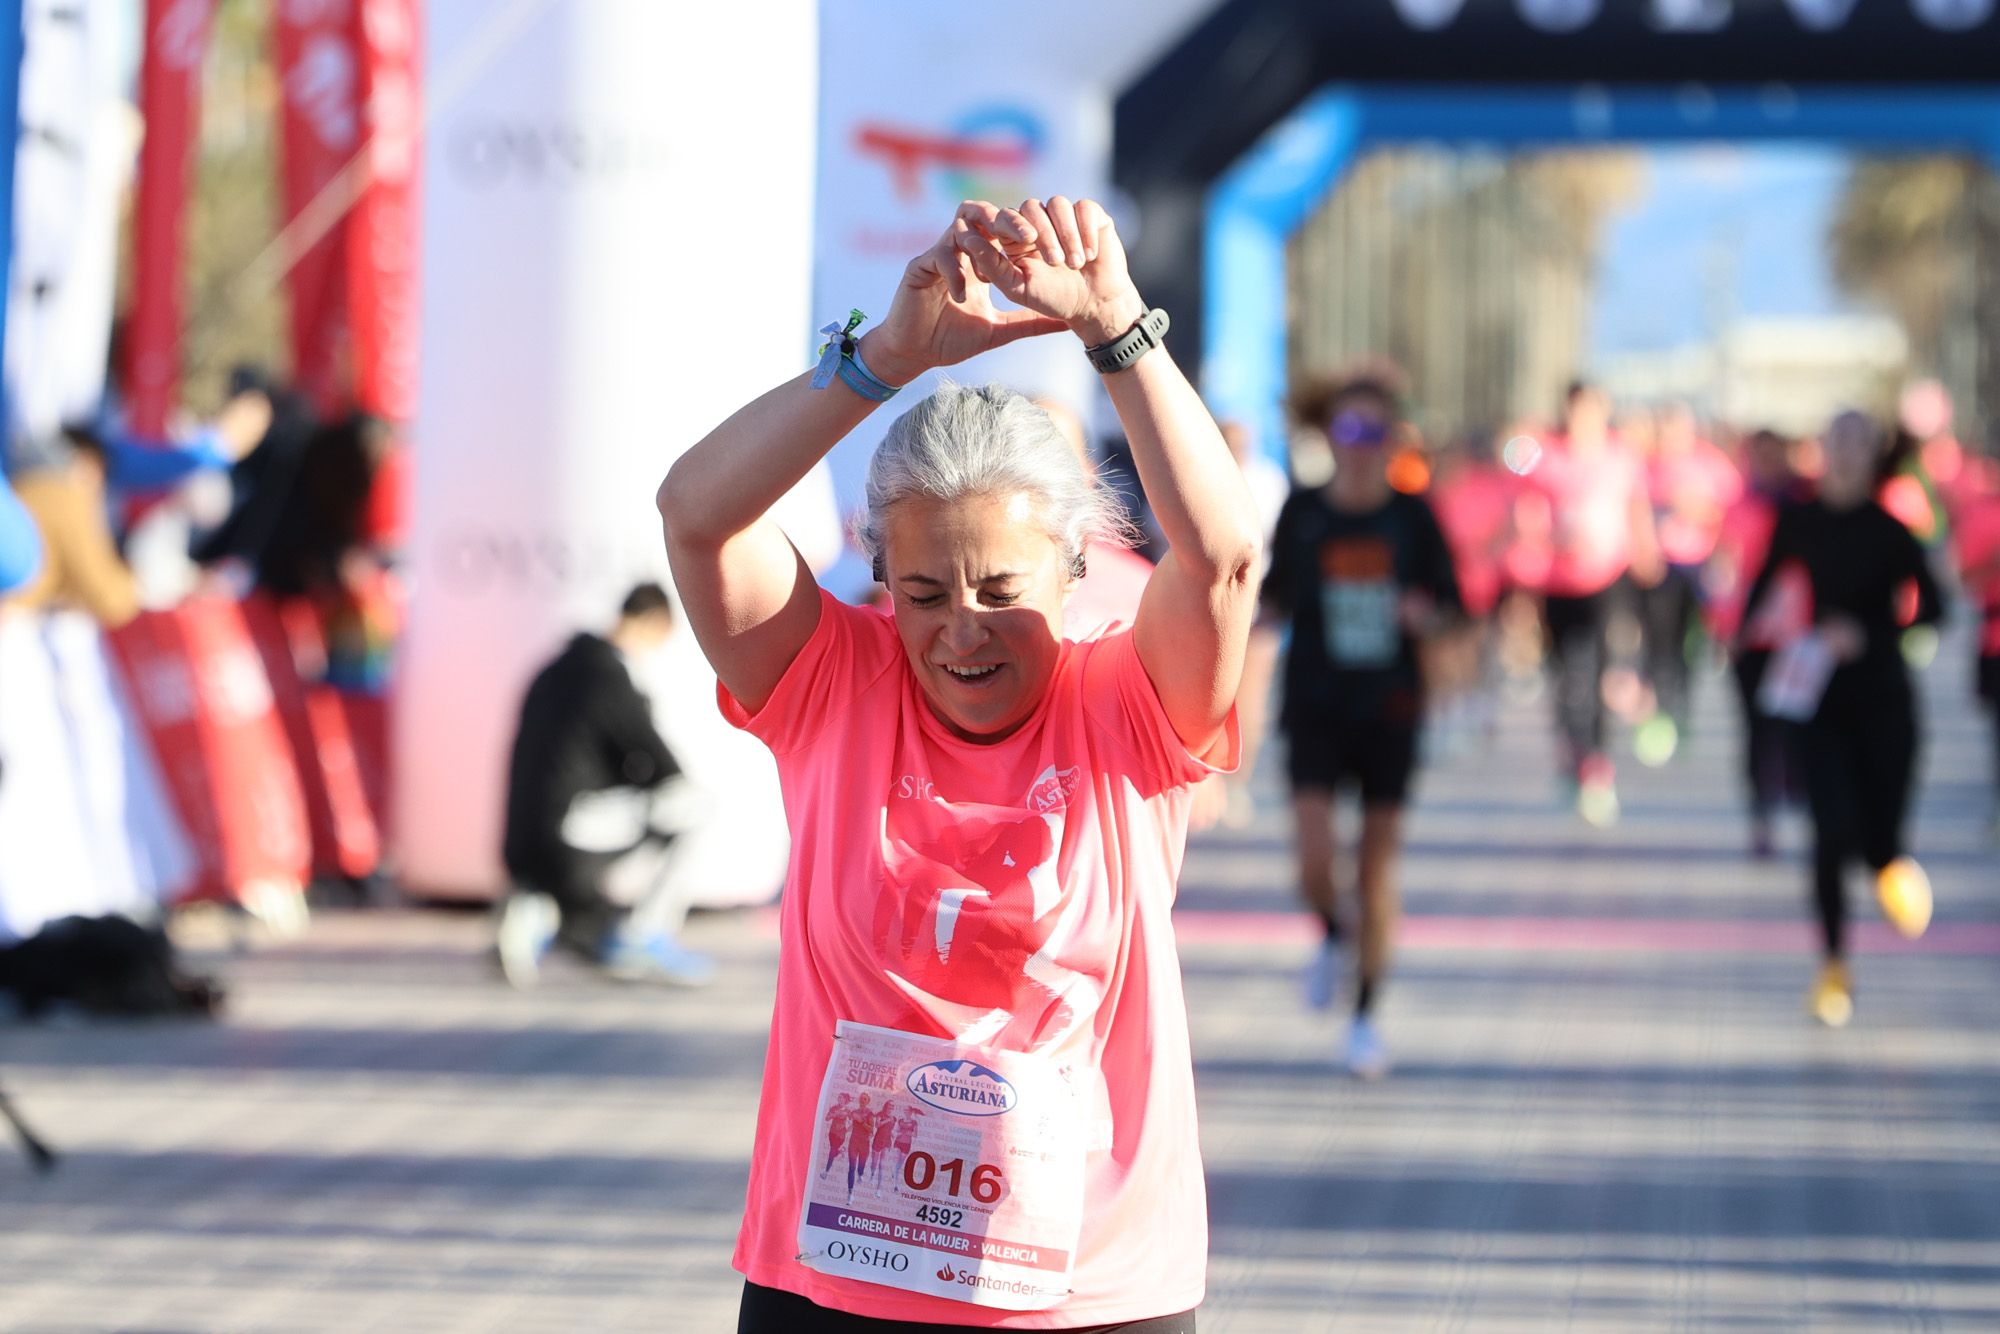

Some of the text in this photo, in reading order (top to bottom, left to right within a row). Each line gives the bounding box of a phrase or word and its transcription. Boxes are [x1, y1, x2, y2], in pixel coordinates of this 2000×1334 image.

[846, 1069, 895, 1091] SUMA
[849, 1058, 897, 1077] TU DORSAL
[933, 1073, 968, 1086] CENTRAL
[913, 1072, 1008, 1109] ASTURIANA
[904, 1150, 1002, 1204] 016
[916, 1204, 964, 1229] 4592
[931, 1197, 961, 1210] VIOLENCIA
[838, 1214, 1039, 1265] CARRERA DE LA MUJER VALENCIA
[827, 1240, 909, 1273] OYSHO
[957, 1269, 1038, 1297] Santander
